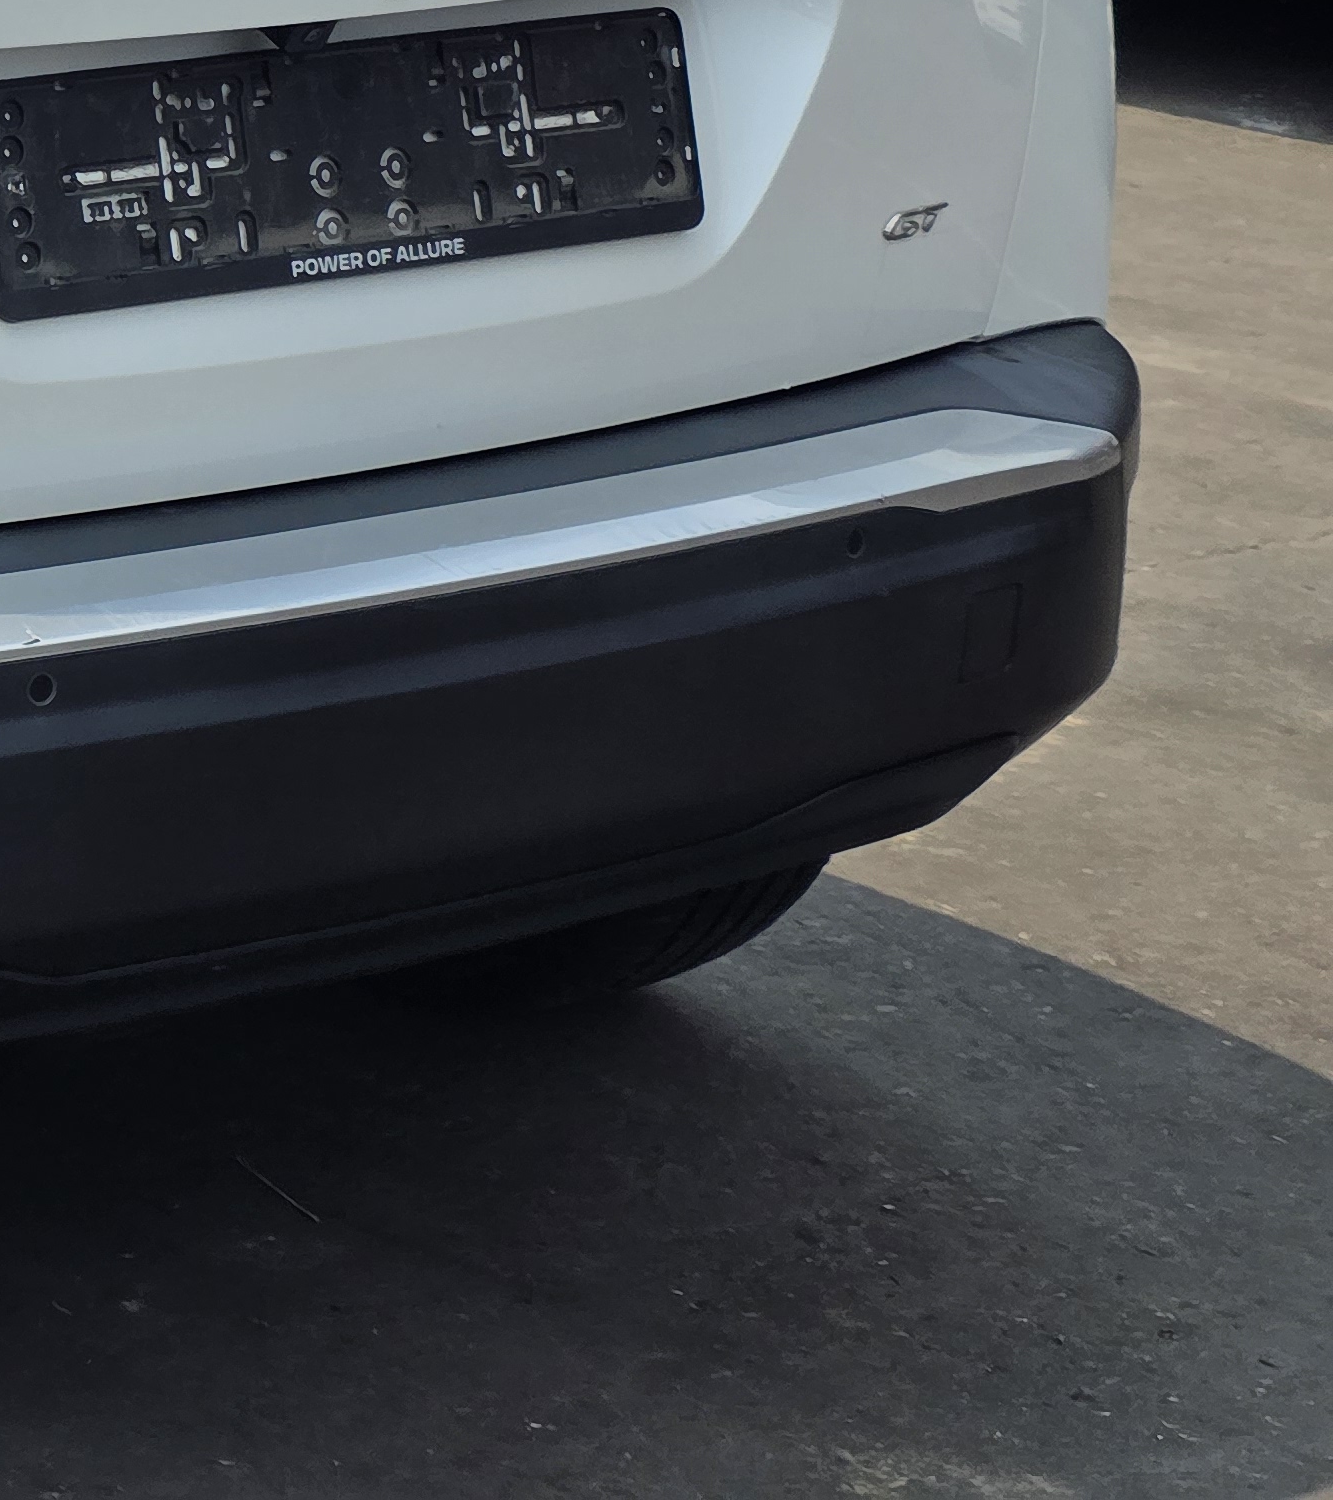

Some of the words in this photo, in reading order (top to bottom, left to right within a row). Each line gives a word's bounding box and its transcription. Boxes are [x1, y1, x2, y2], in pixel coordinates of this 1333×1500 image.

[882, 202, 949, 241] GT
[291, 252, 364, 278] POWER
[366, 248, 392, 266] OF
[395, 237, 466, 264] ALLURE
